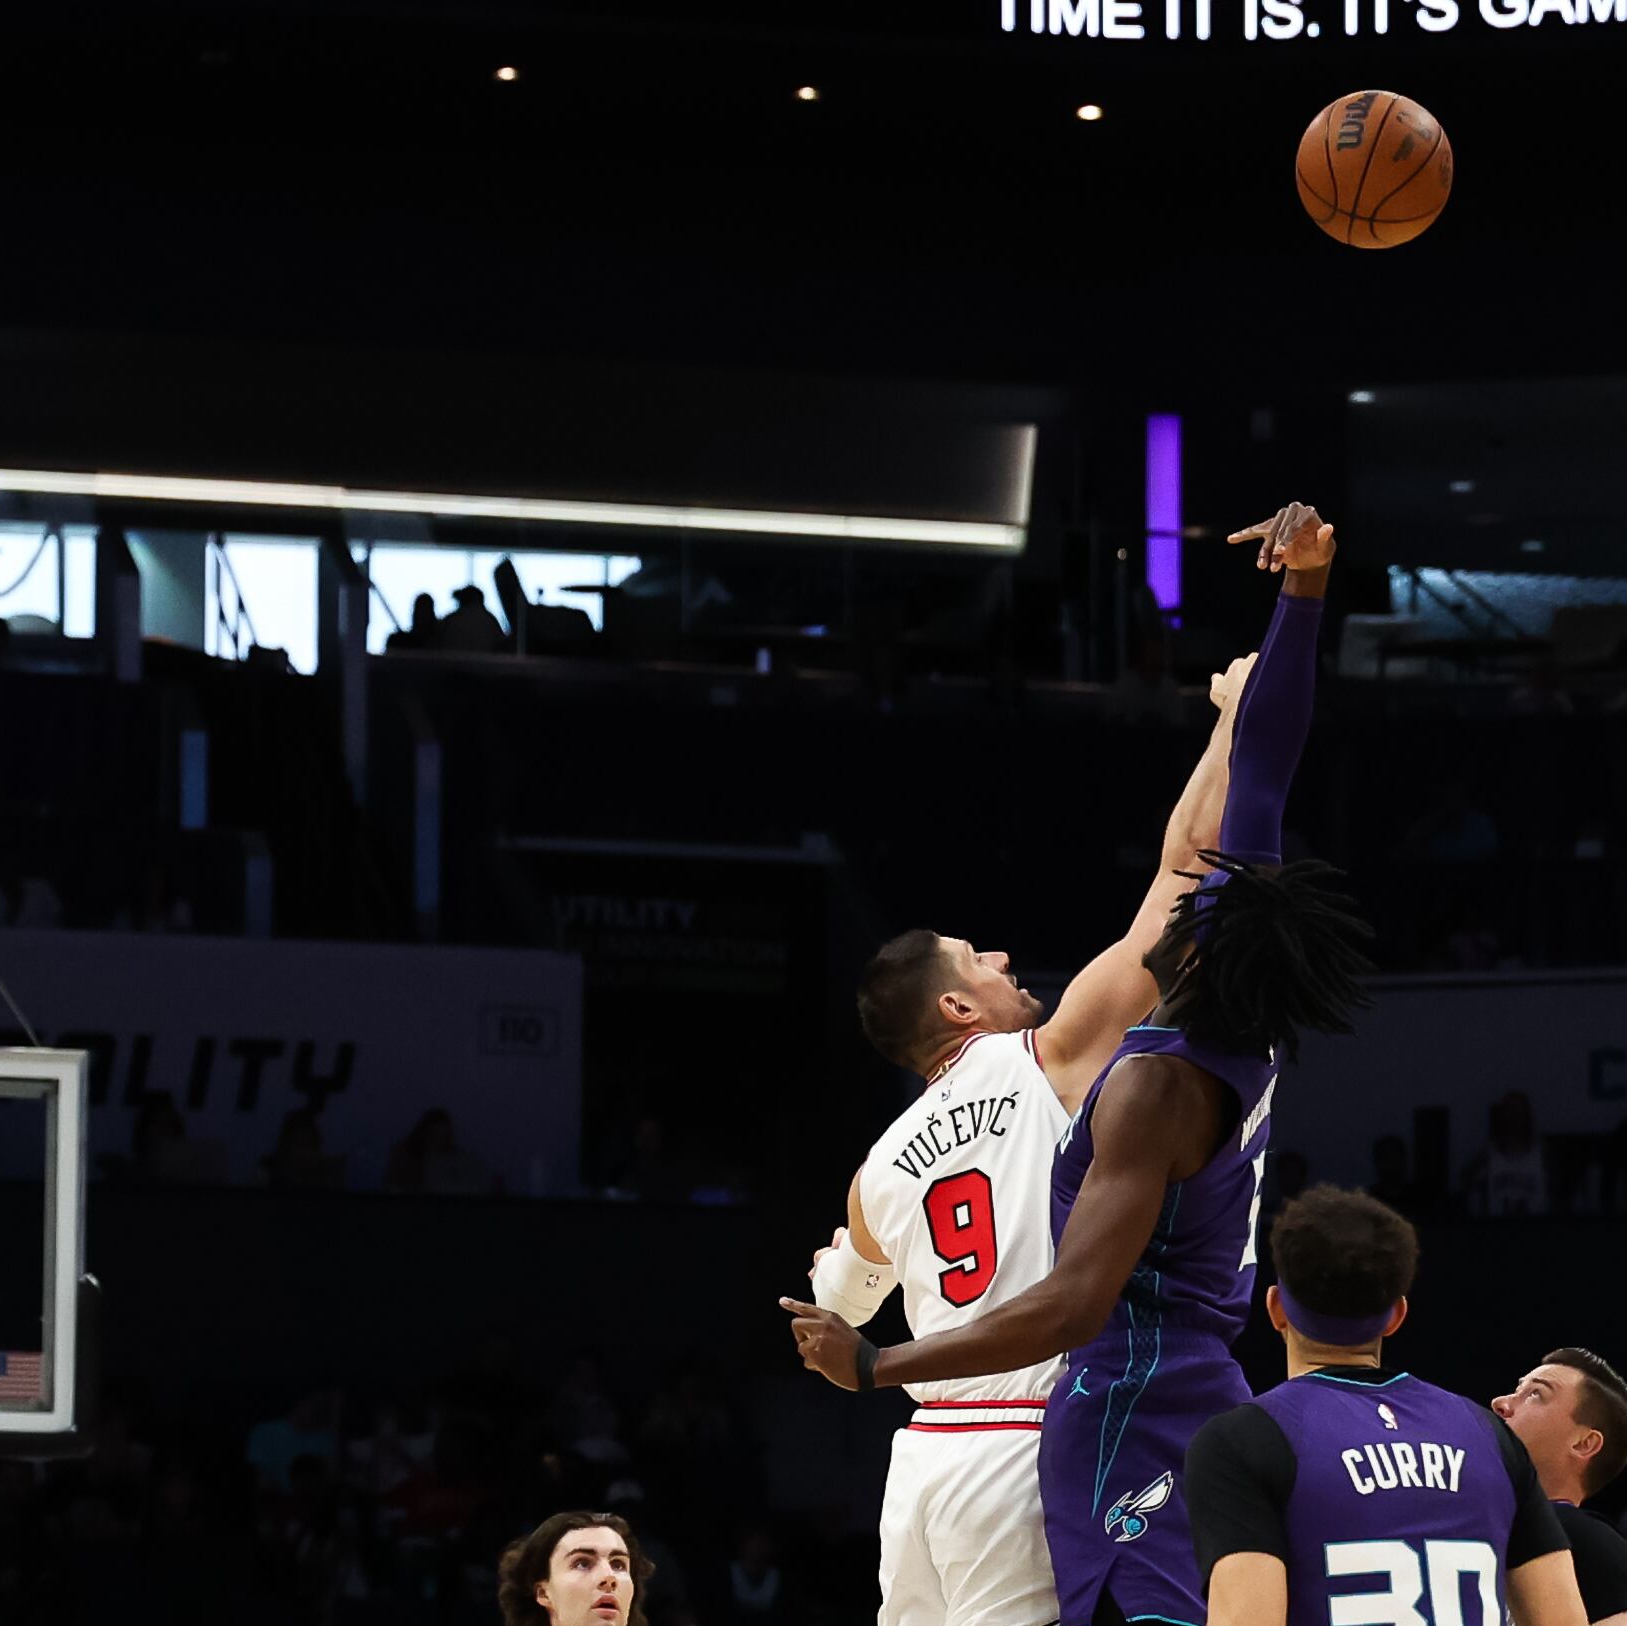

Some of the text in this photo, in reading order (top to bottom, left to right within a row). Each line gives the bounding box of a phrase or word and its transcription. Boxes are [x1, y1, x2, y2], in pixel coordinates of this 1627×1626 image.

[1344, 0, 1460, 36] ITS
[892, 1090, 1020, 1179] VUČEVIĆ
[923, 1168, 998, 1308] 9
[1340, 1441, 1468, 1497] CURRY
